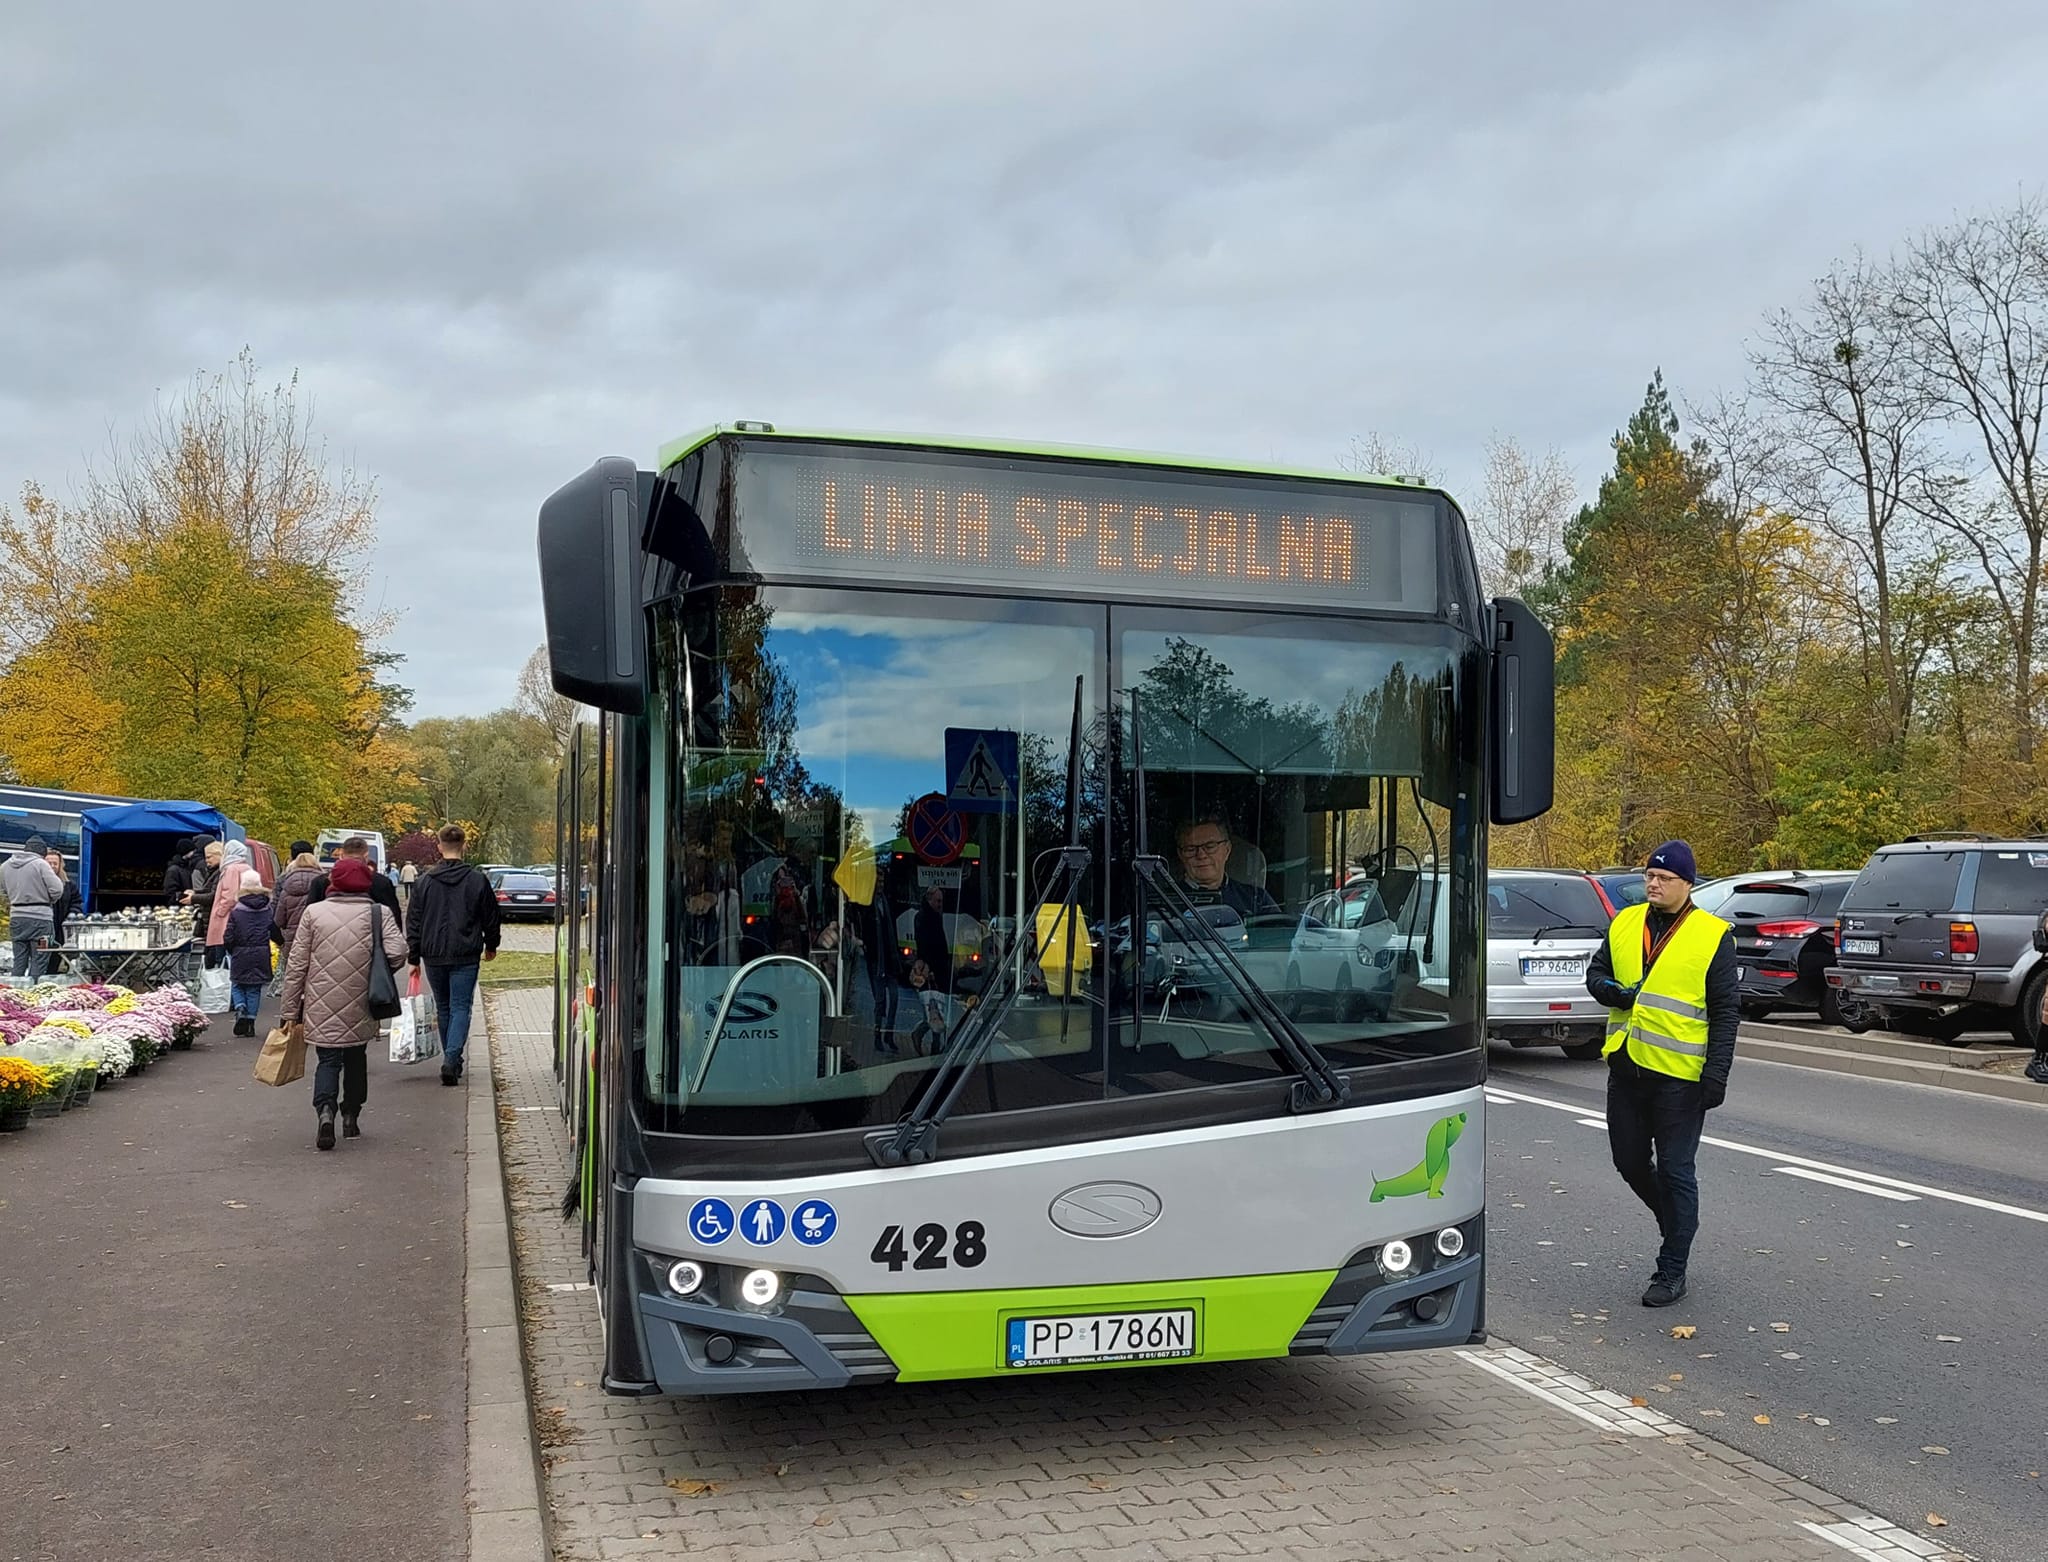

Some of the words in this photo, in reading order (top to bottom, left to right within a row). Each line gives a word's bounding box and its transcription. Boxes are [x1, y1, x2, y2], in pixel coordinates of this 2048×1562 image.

[824, 480, 989, 557] LINIA
[1014, 495, 1353, 581] SPECJALNA
[1847, 940, 1856, 951] PP
[1531, 961, 1545, 973] PP
[1548, 961, 1580, 973] 9642P
[870, 1220, 987, 1272] 428
[1032, 1322, 1073, 1355] PP
[1090, 1315, 1185, 1351] 1786N
[1011, 1344, 1023, 1353] PL
[1027, 1358, 1062, 1367] SOLARIS
